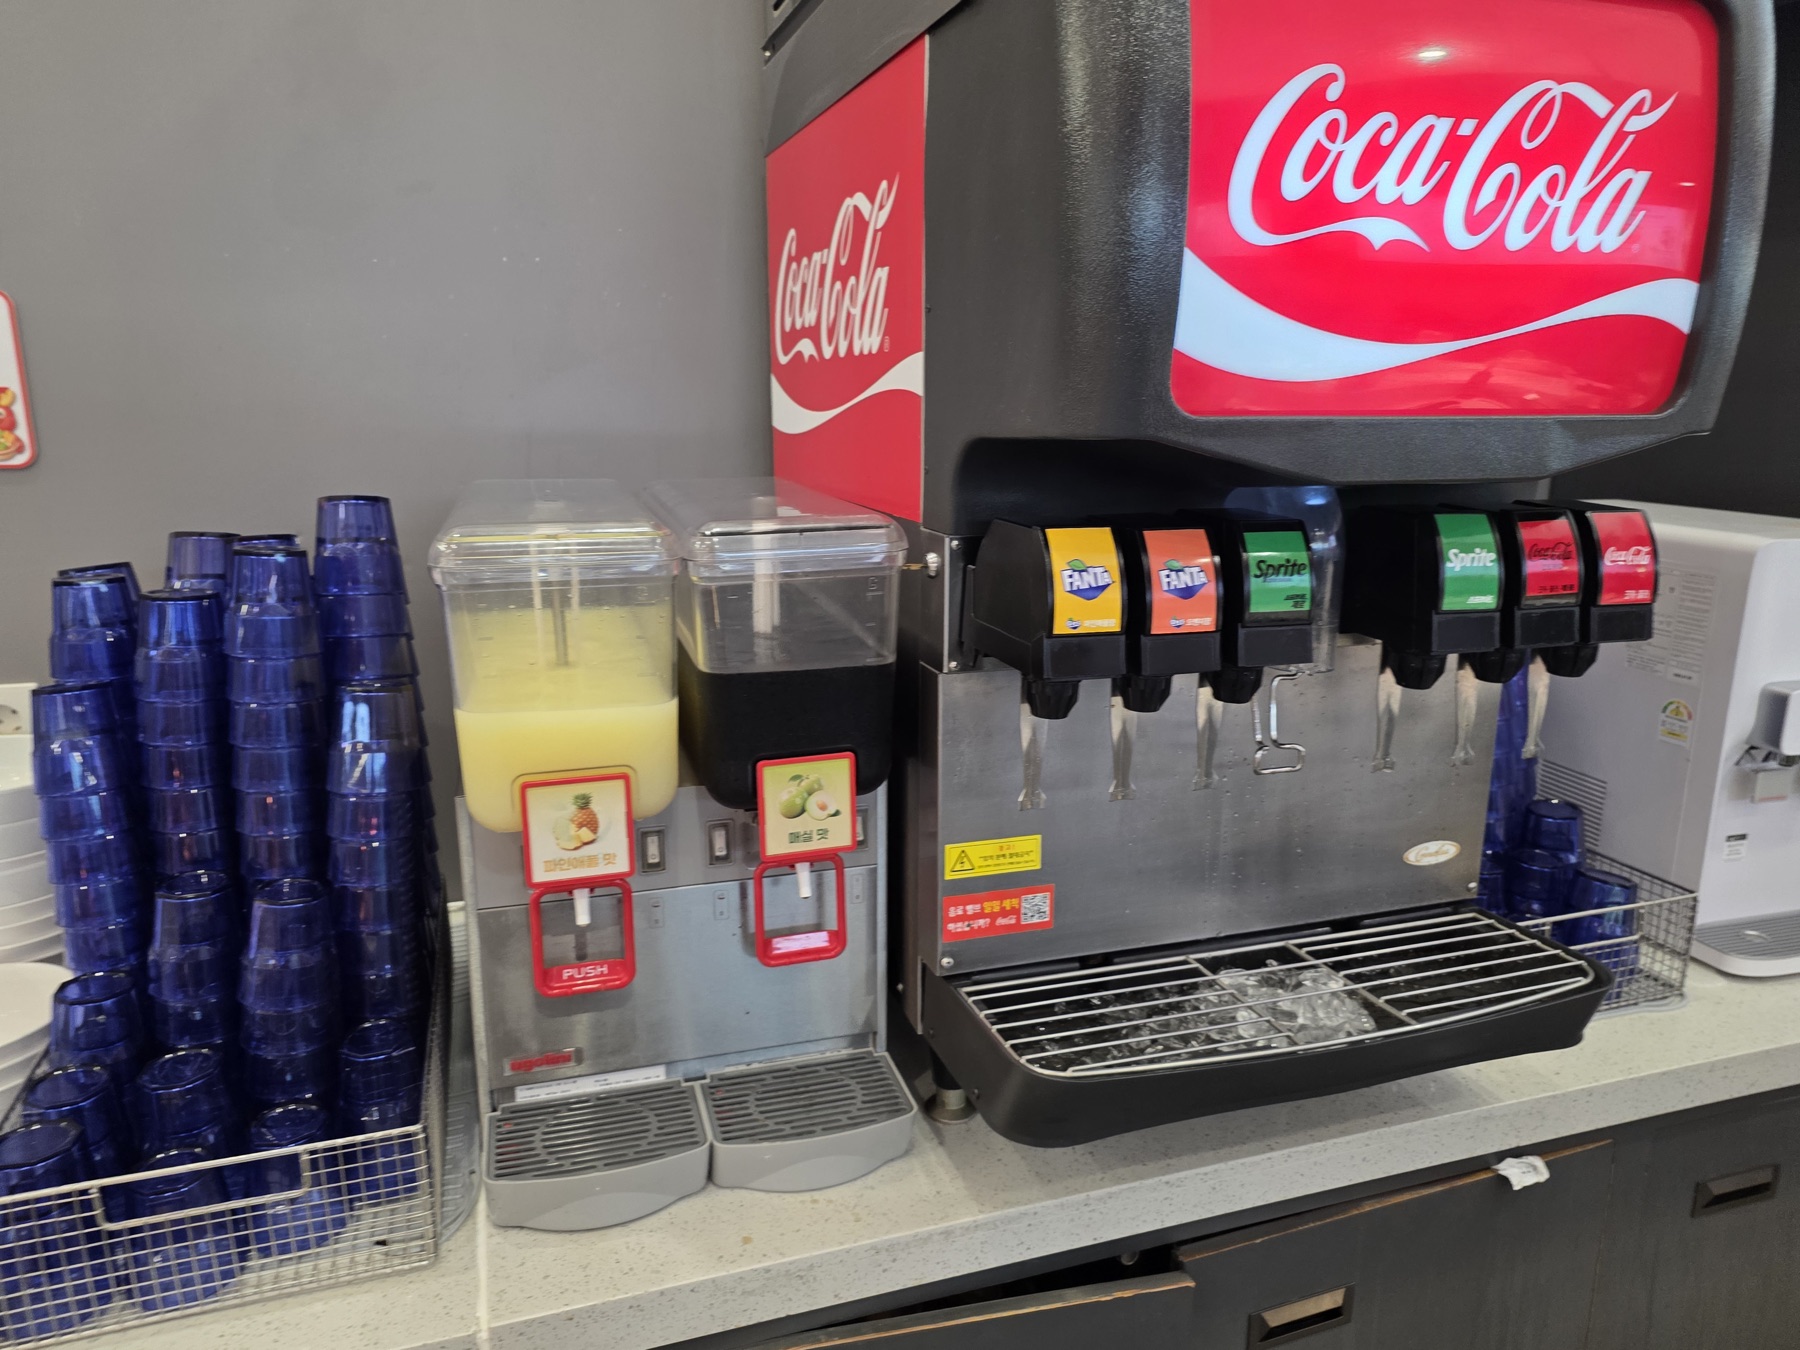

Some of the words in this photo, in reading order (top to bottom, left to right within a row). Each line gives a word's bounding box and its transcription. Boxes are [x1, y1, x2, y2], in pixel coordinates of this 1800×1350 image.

[1228, 63, 1679, 253] Coca-Cola
[775, 172, 900, 365] Coca-Cola
[1445, 547, 1497, 572] Sprite
[1604, 545, 1652, 566] Coca-Cola
[1252, 558, 1308, 583] Sprite
[788, 830, 814, 844] 매실
[816, 827, 829, 841] 맛
[543, 855, 599, 873] 파인애플
[602, 852, 617, 866] 맛
[562, 964, 609, 980] PUSH
